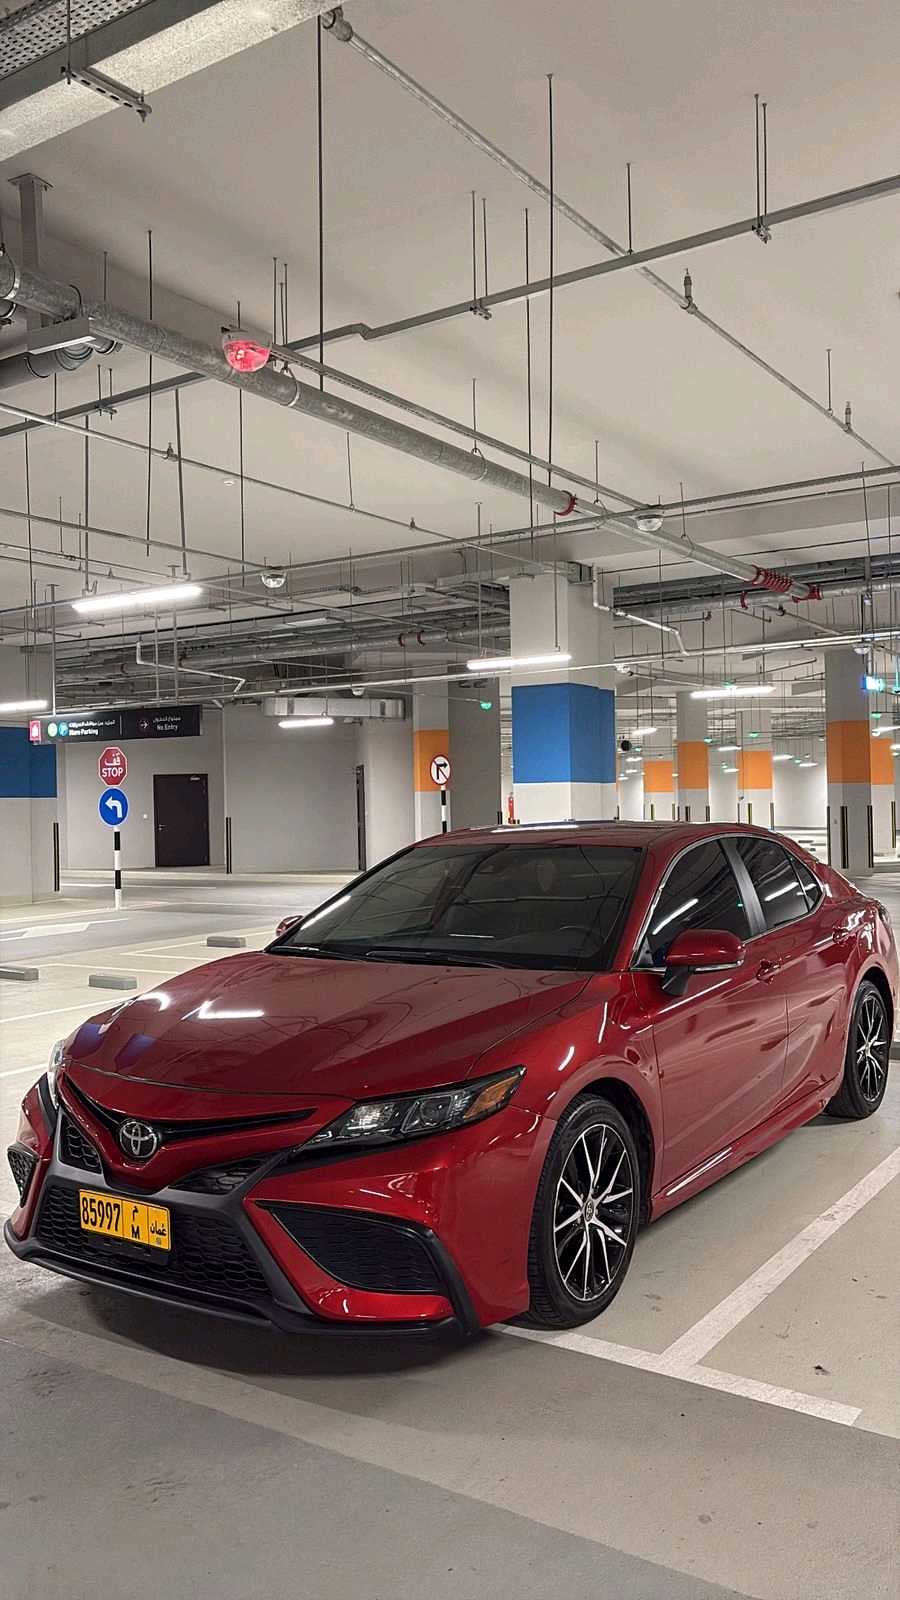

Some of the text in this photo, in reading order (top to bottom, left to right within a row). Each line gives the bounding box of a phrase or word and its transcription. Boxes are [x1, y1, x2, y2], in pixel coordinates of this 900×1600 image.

[80, 728, 99, 736] Parking
[164, 723, 178, 731] Entry
[101, 766, 124, 778] STOP
[81, 1196, 121, 1232] 85997
[131, 1224, 140, 1240] M
